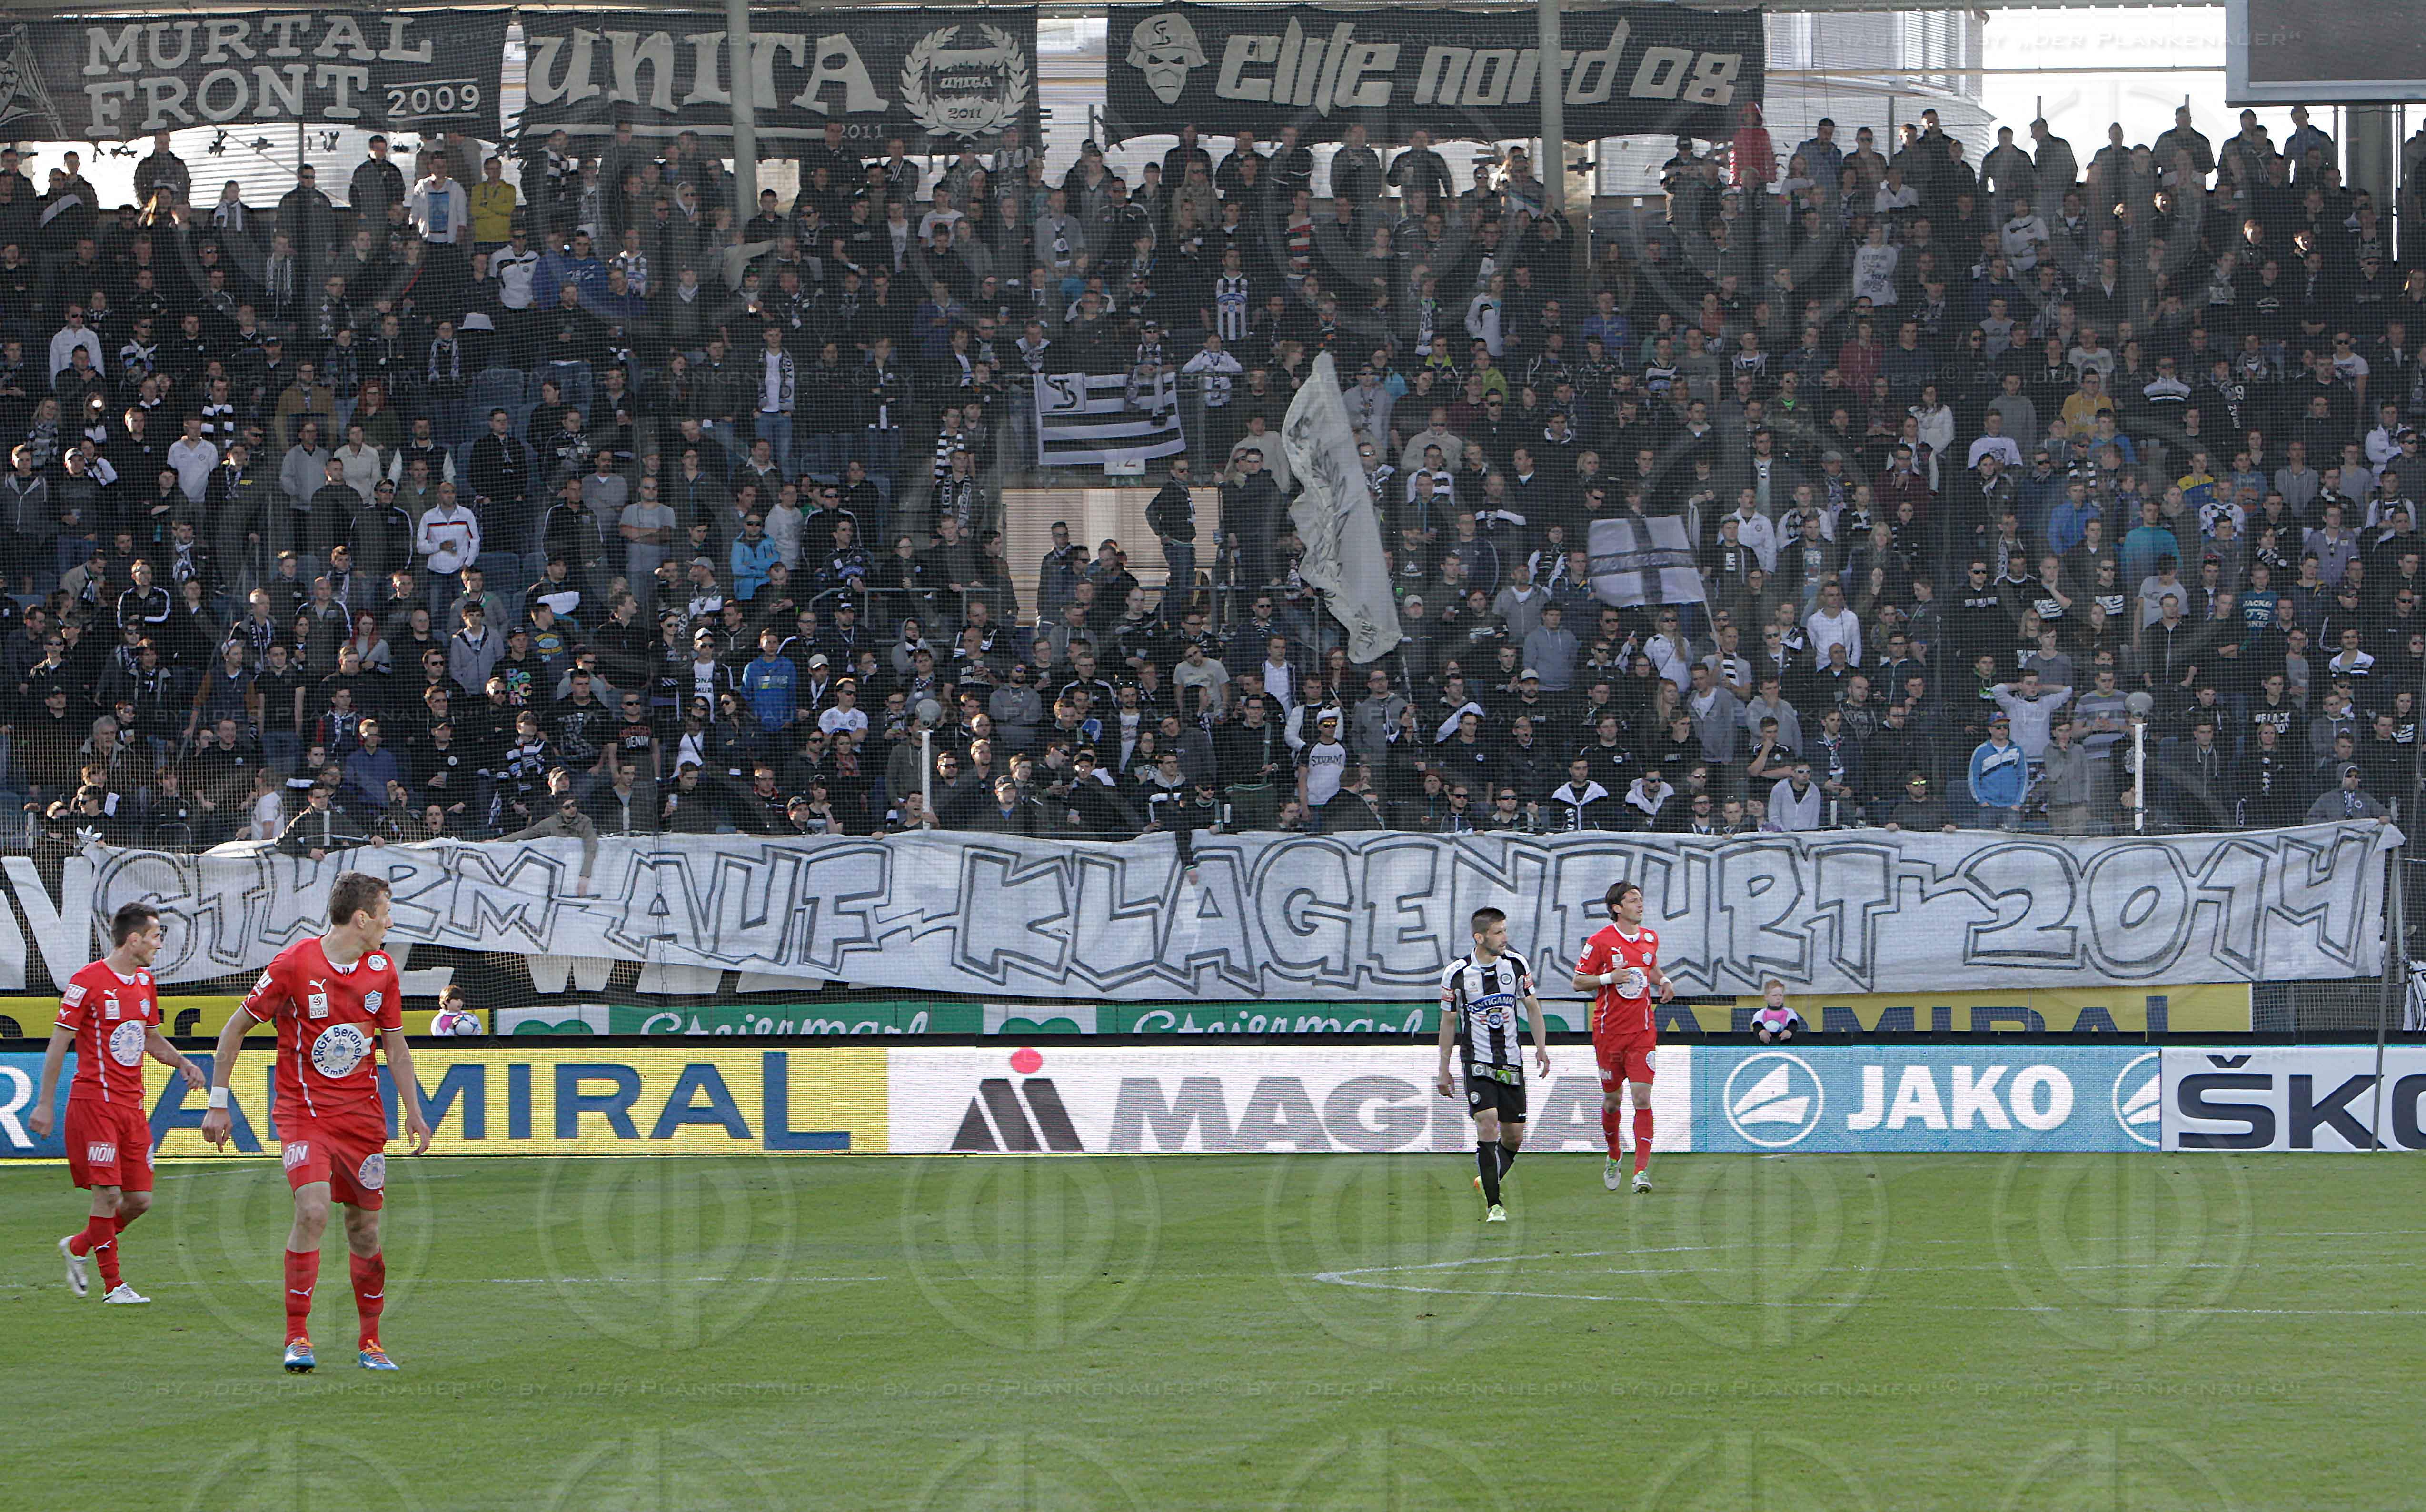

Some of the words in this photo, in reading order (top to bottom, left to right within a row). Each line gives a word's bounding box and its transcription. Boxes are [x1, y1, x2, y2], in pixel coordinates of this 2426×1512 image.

[83, 15, 432, 75] MURTAL
[84, 64, 368, 137] FRONT
[387, 84, 480, 116] 2009
[1630, 46, 1742, 106] 08
[948, 108, 982, 119] 2011
[1311, 754, 1342, 767] STURM
[313, 1034, 332, 1064] ERGE
[333, 1026, 361, 1061] Beranek
[151, 1050, 851, 1151] AMIRAL
[1847, 1064, 2075, 1130] JAKO
[88, 1144, 116, 1163] NÖN
